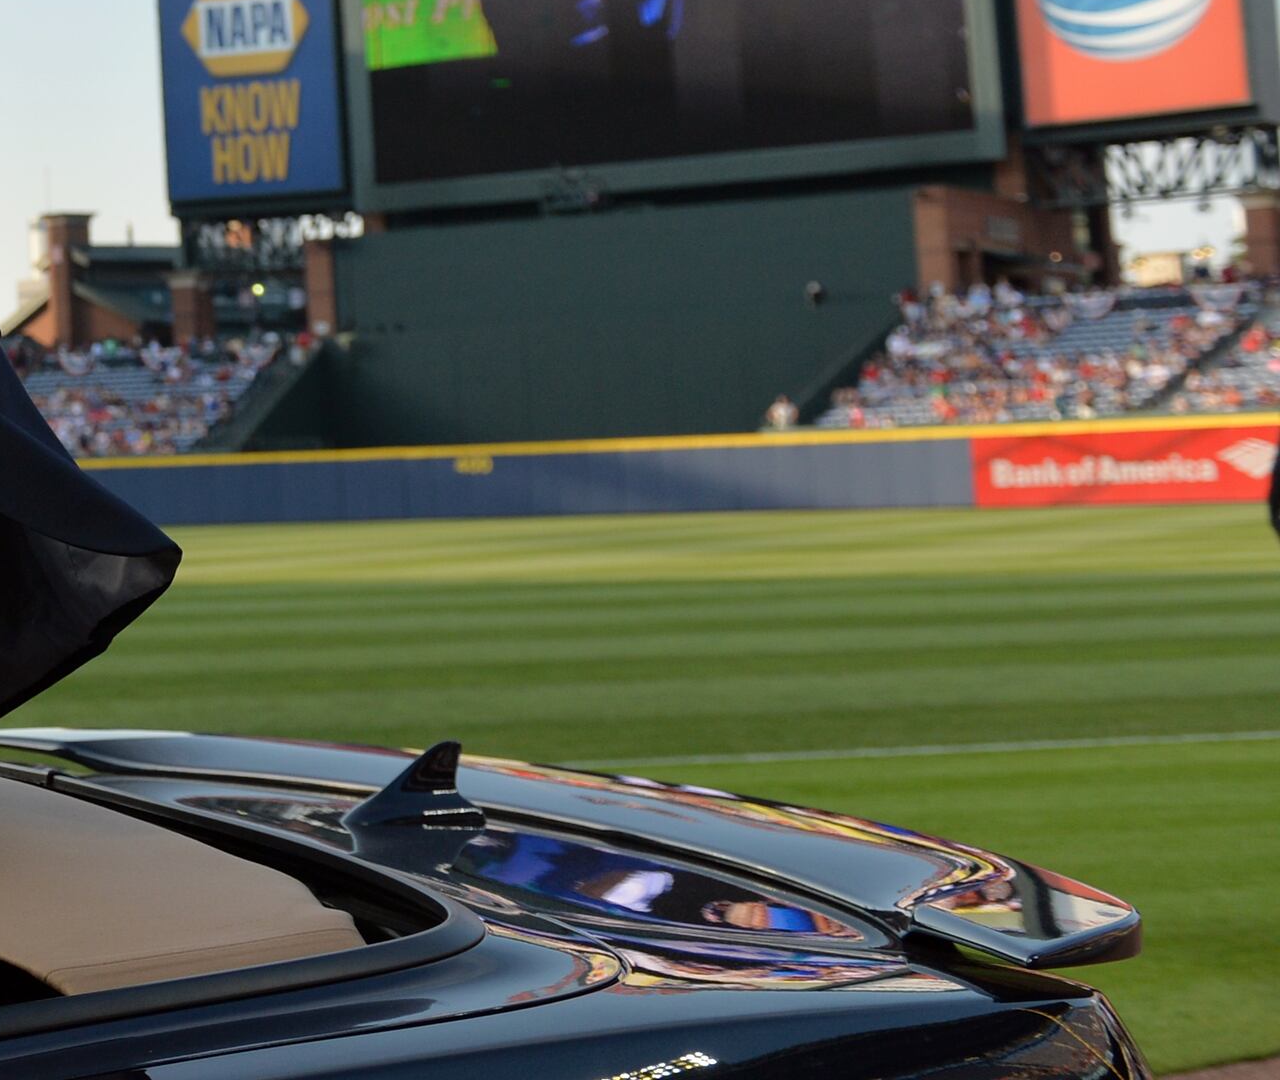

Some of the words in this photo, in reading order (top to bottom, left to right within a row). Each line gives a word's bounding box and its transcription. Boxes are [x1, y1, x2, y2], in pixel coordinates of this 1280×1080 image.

[205, 0, 289, 50] NAPA
[200, 78, 301, 136] KNOW
[212, 132, 290, 184] HOW
[990, 457, 1063, 489] Bank
[1067, 454, 1096, 486] of
[1097, 452, 1219, 484] America
